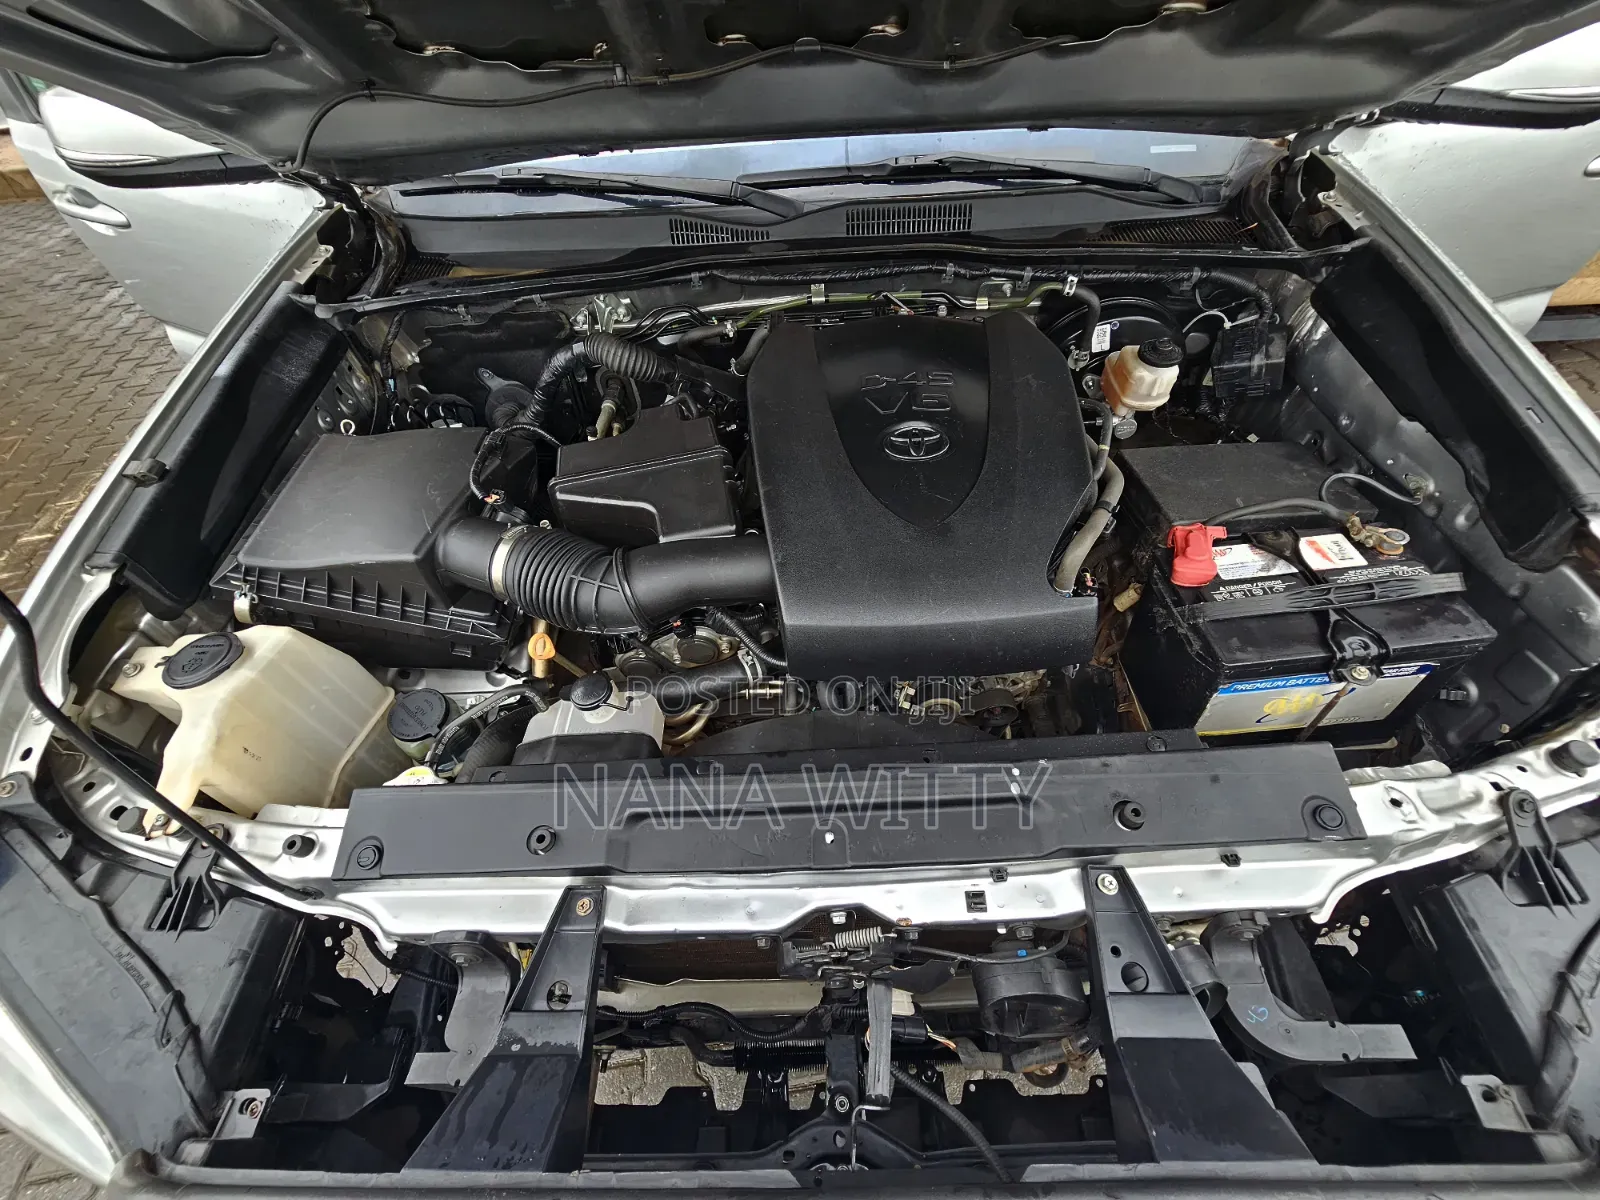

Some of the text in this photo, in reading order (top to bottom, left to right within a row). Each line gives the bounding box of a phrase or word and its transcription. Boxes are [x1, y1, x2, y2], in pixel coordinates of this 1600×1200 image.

[864, 391, 952, 414] V6
[1231, 677, 1330, 691] PREMIUM BATTER
